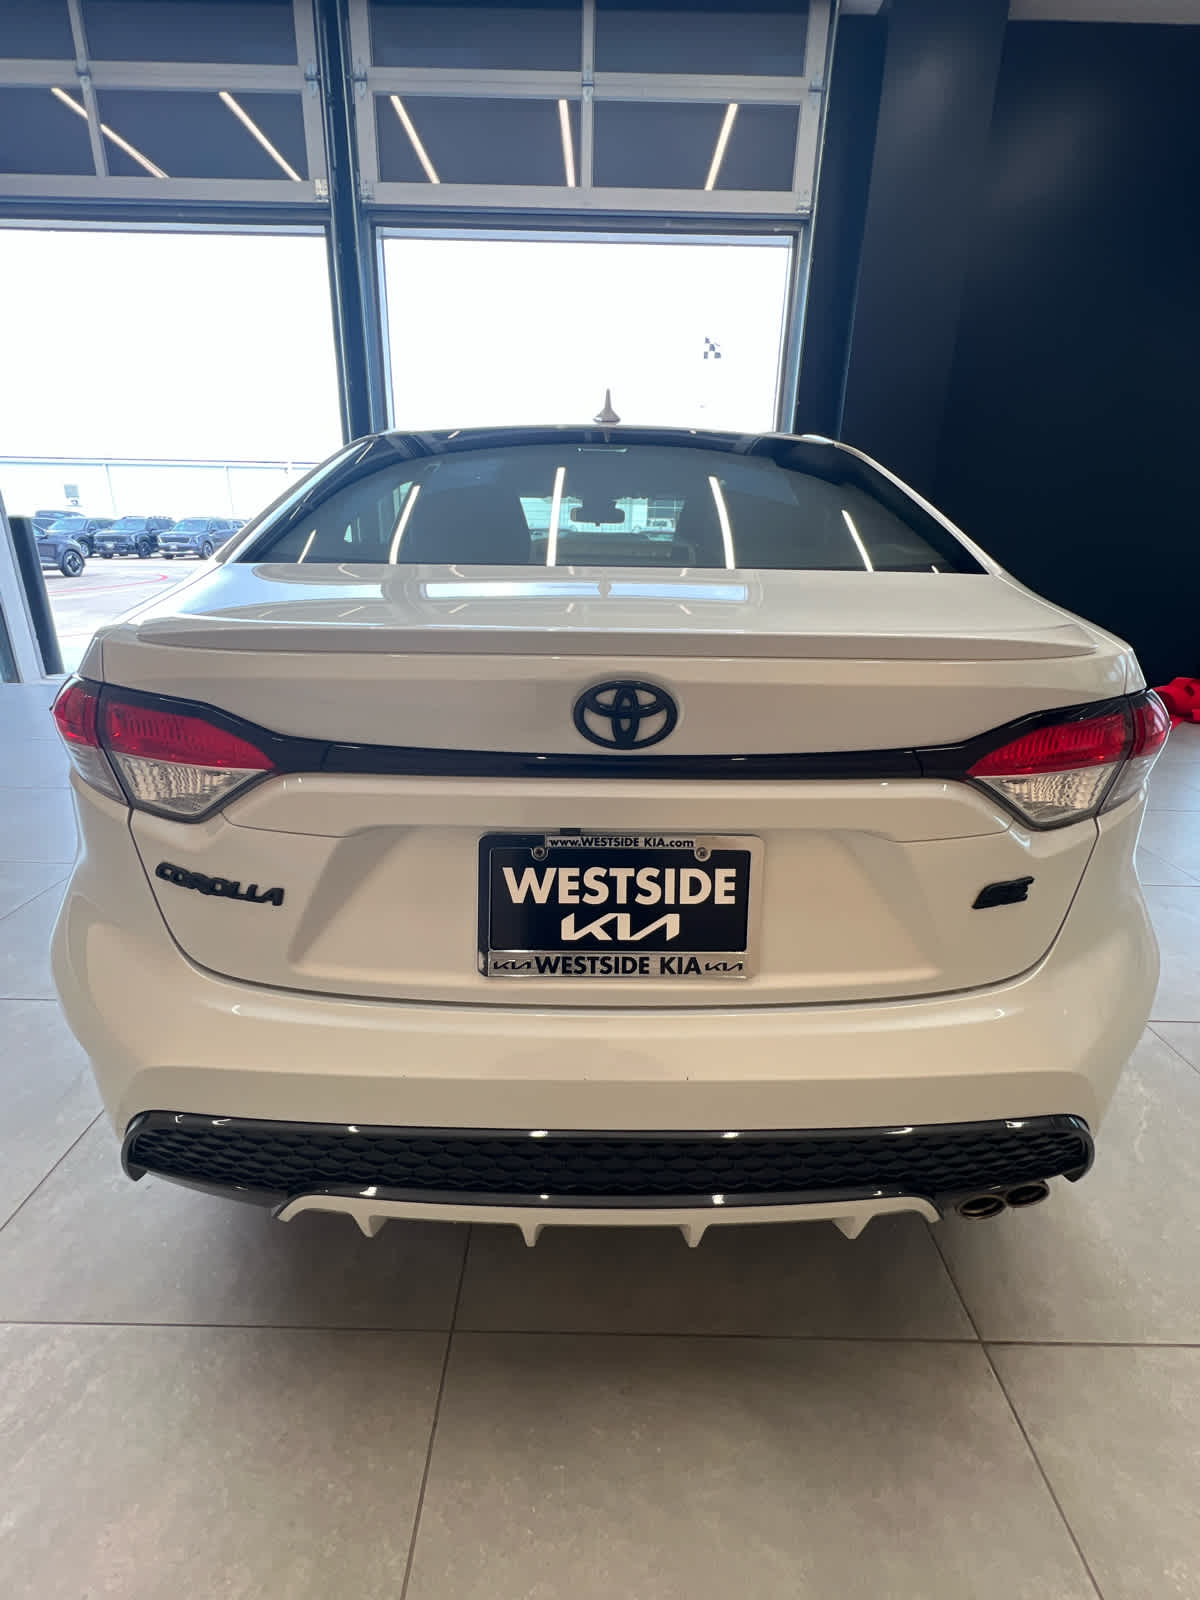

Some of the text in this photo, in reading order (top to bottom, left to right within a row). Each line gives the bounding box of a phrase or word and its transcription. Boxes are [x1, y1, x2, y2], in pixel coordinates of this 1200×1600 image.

[643, 837, 695, 849] KIA.com
[155, 862, 285, 906] COROLLA
[502, 866, 737, 906] WESTSIDE
[560, 912, 681, 941] KIA
[535, 955, 650, 975] WESTSIDE
[659, 956, 703, 975] KIA
